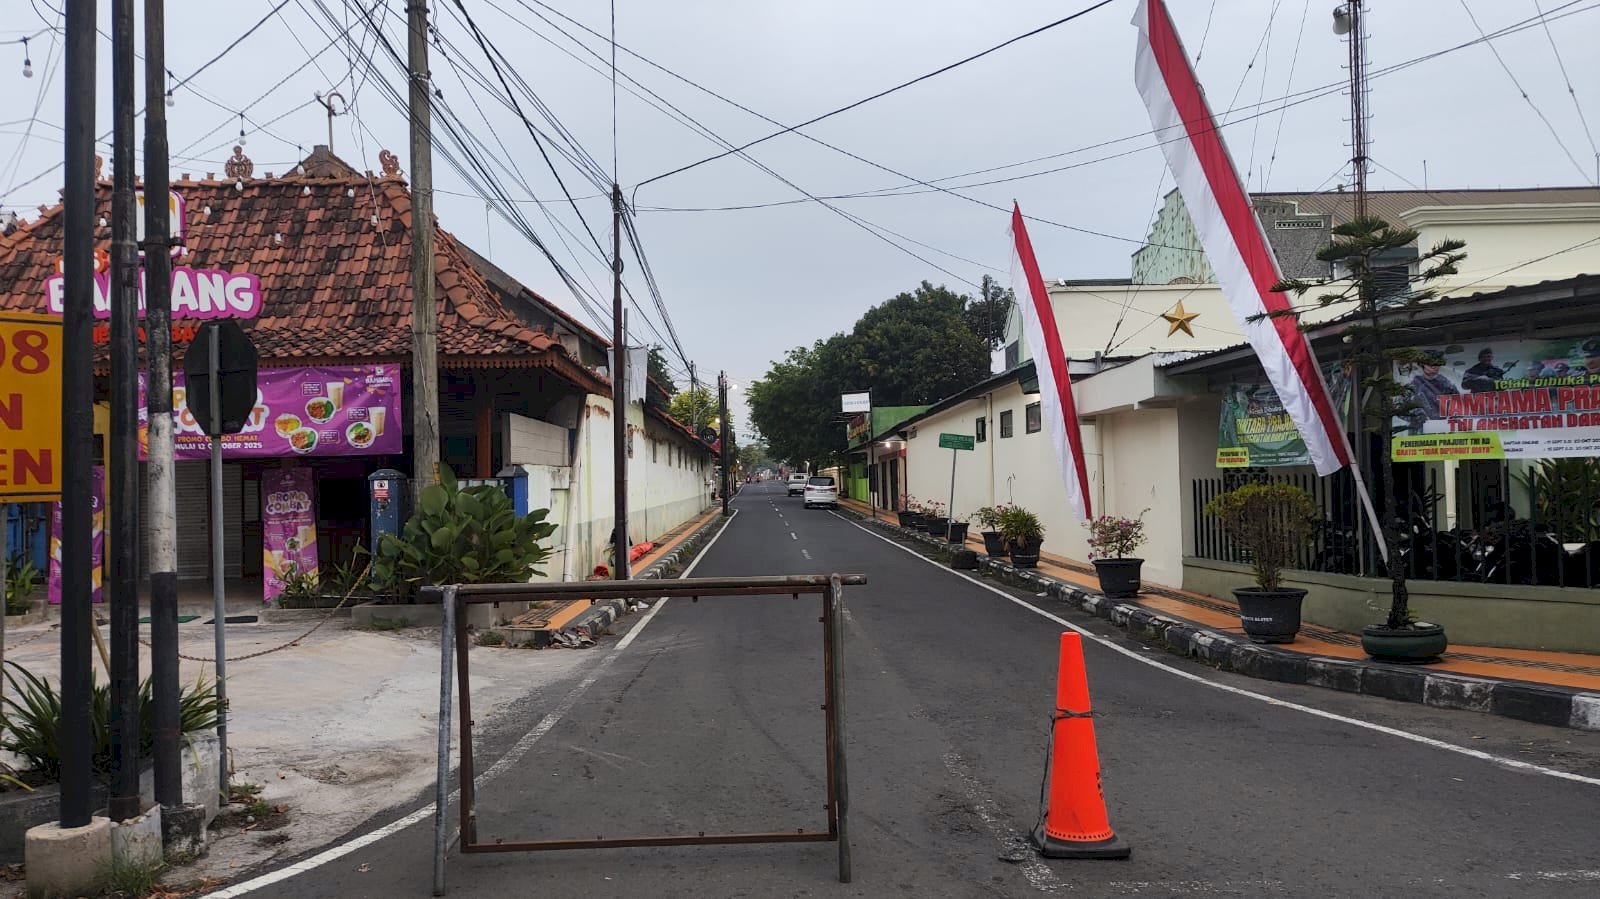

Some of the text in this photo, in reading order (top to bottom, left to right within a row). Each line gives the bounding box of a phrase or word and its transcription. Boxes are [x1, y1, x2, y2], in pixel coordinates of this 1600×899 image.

[1436, 386, 1551, 417] TAMTAMA
[1476, 414, 1563, 431] ANGKATAN
[268, 491, 307, 503] PROMO
